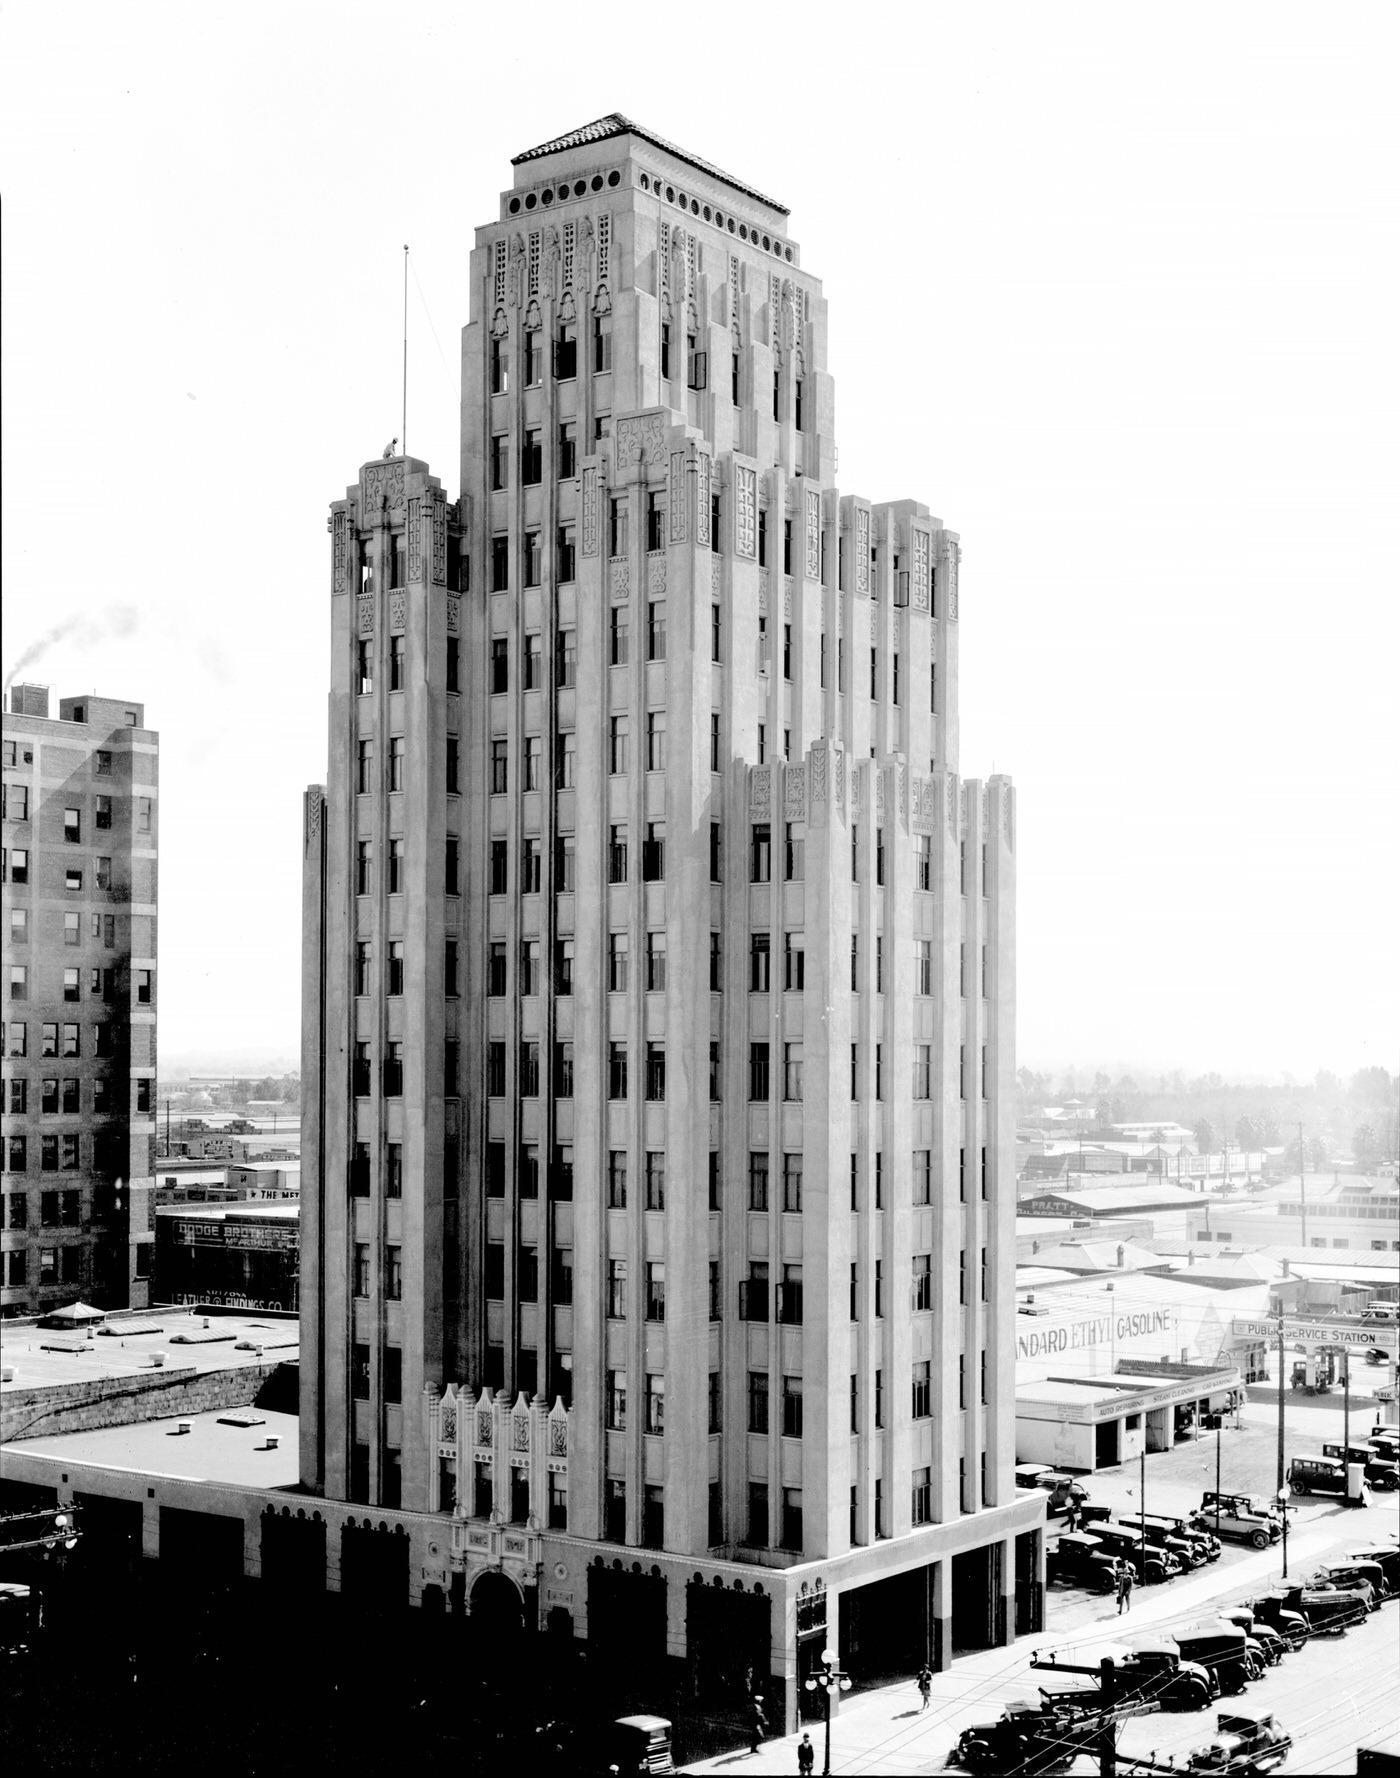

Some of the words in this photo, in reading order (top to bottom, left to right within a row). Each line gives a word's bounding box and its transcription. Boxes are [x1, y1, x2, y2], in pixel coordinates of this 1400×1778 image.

[261, 1190, 277, 1200] THE
[178, 1223, 219, 1236] DODGE
[223, 1226, 289, 1240] BROTHERS
[1117, 1309, 1170, 1340] GASOLINE
[1332, 1330, 1376, 1343] STATION
[1153, 1392, 1171, 1403] STEAM
[1171, 1387, 1195, 1398] CLEANING
[1100, 1406, 1114, 1416] AUTO
[1115, 1400, 1145, 1413] REPAIRING
